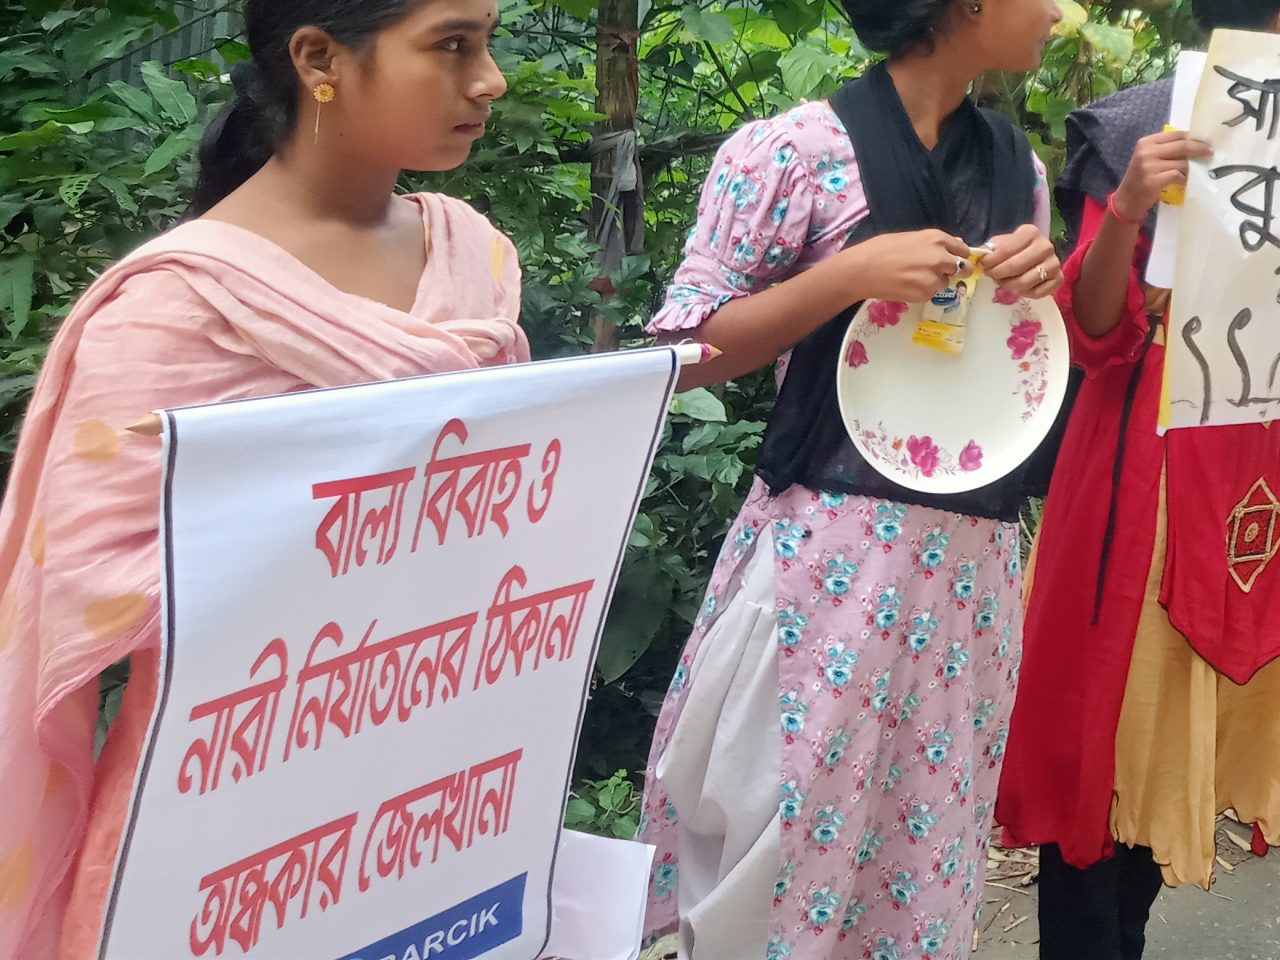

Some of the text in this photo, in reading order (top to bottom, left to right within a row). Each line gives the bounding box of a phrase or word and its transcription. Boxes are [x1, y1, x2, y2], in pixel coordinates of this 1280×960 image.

[312, 418, 562, 578] বাল্য বিবাহ ও
[178, 564, 595, 795] নারী নির্যাতনের ঠিকানা
[190, 747, 523, 956] অন্ধকার জেলখানা
